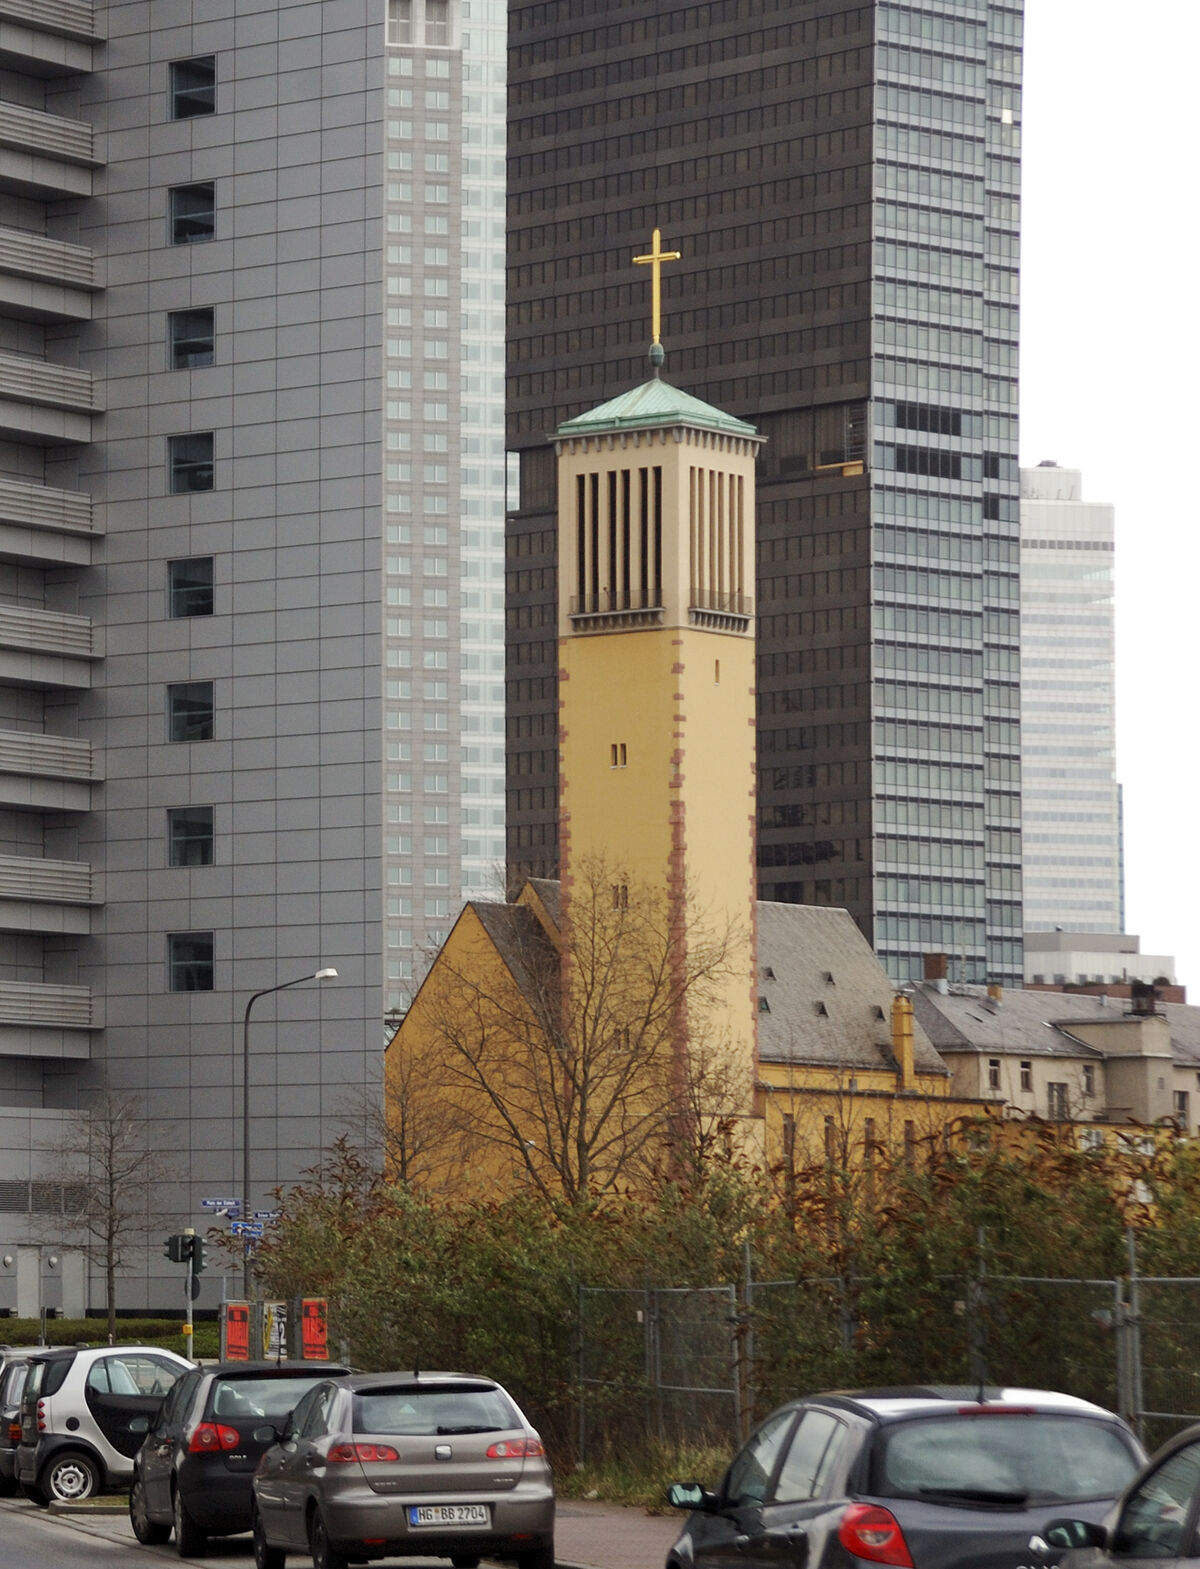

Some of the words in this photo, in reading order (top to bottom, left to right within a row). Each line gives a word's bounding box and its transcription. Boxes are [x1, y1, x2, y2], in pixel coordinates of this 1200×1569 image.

[418, 1507, 433, 1521] HG
[441, 1507, 455, 1520] BB
[458, 1506, 484, 1520] 2704
